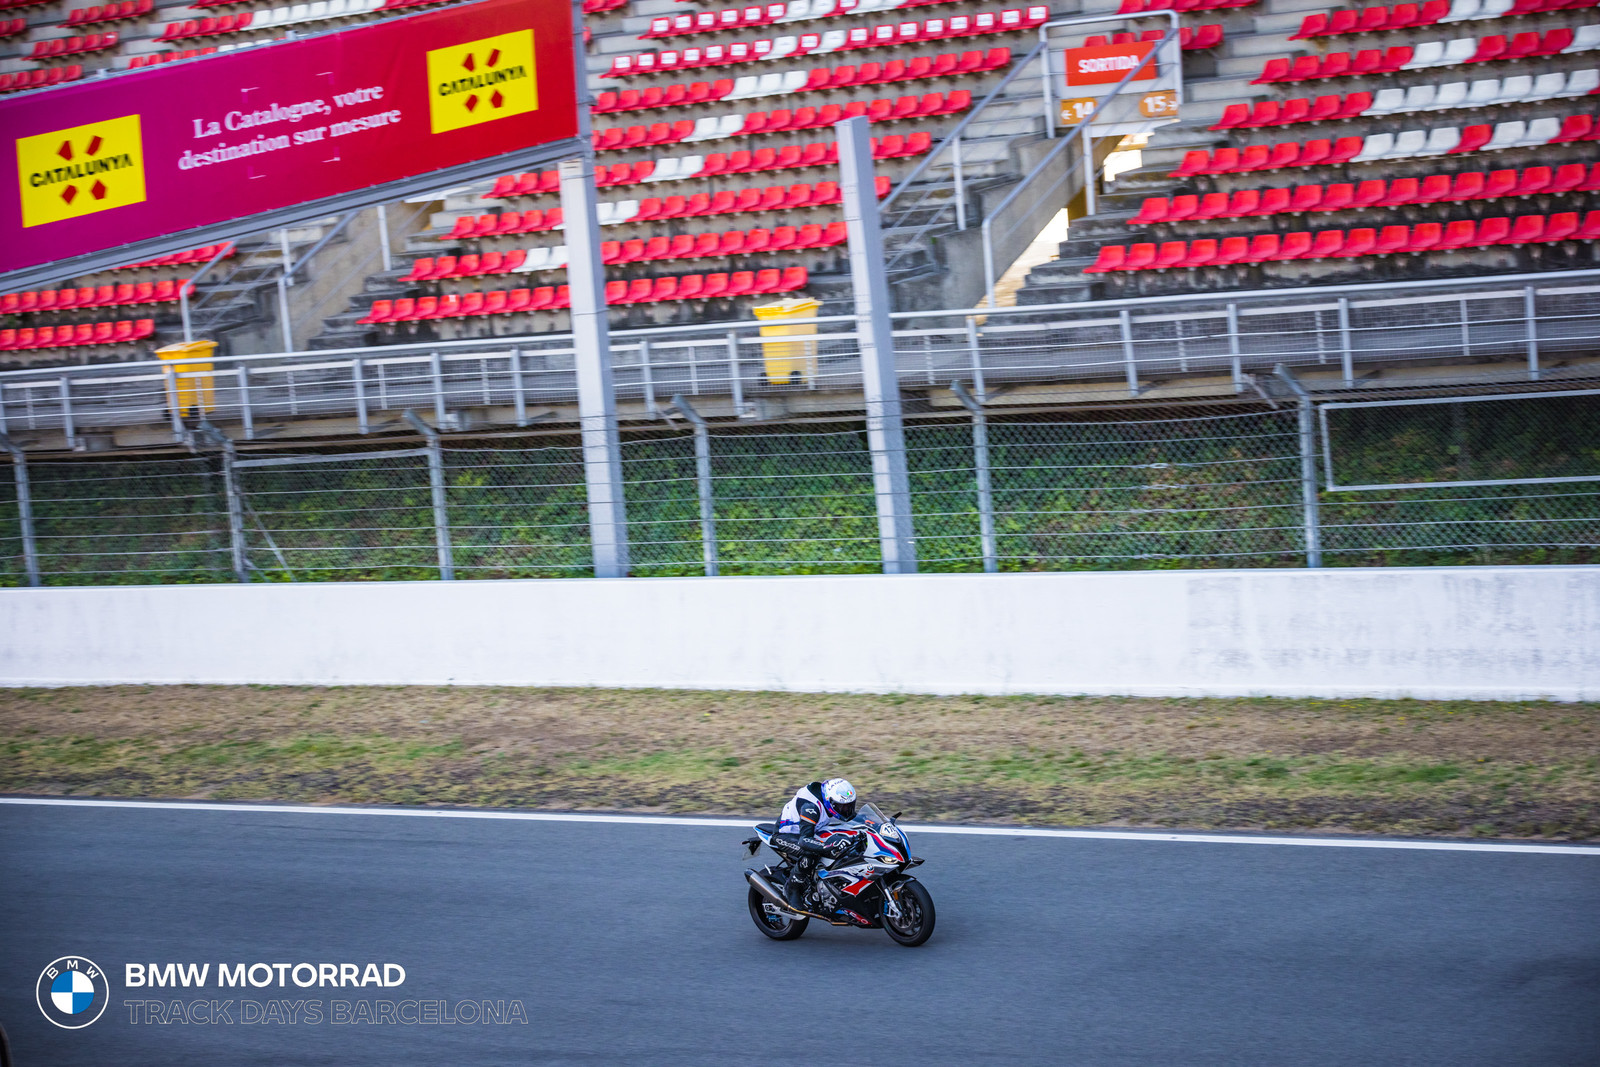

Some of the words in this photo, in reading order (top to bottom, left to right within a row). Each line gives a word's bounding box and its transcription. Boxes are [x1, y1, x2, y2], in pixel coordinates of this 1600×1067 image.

[1078, 55, 1140, 73] SORTIDA
[438, 65, 528, 96] CATALUNYA
[192, 118, 222, 139] La
[224, 99, 332, 123] Catalogne,
[332, 86, 384, 108] votre
[1072, 101, 1094, 118] 14
[1144, 95, 1167, 113] 15
[178, 134, 291, 170] destination
[293, 126, 327, 145] sur
[329, 109, 401, 137] mesure
[29, 153, 134, 188] CATALUNYA
